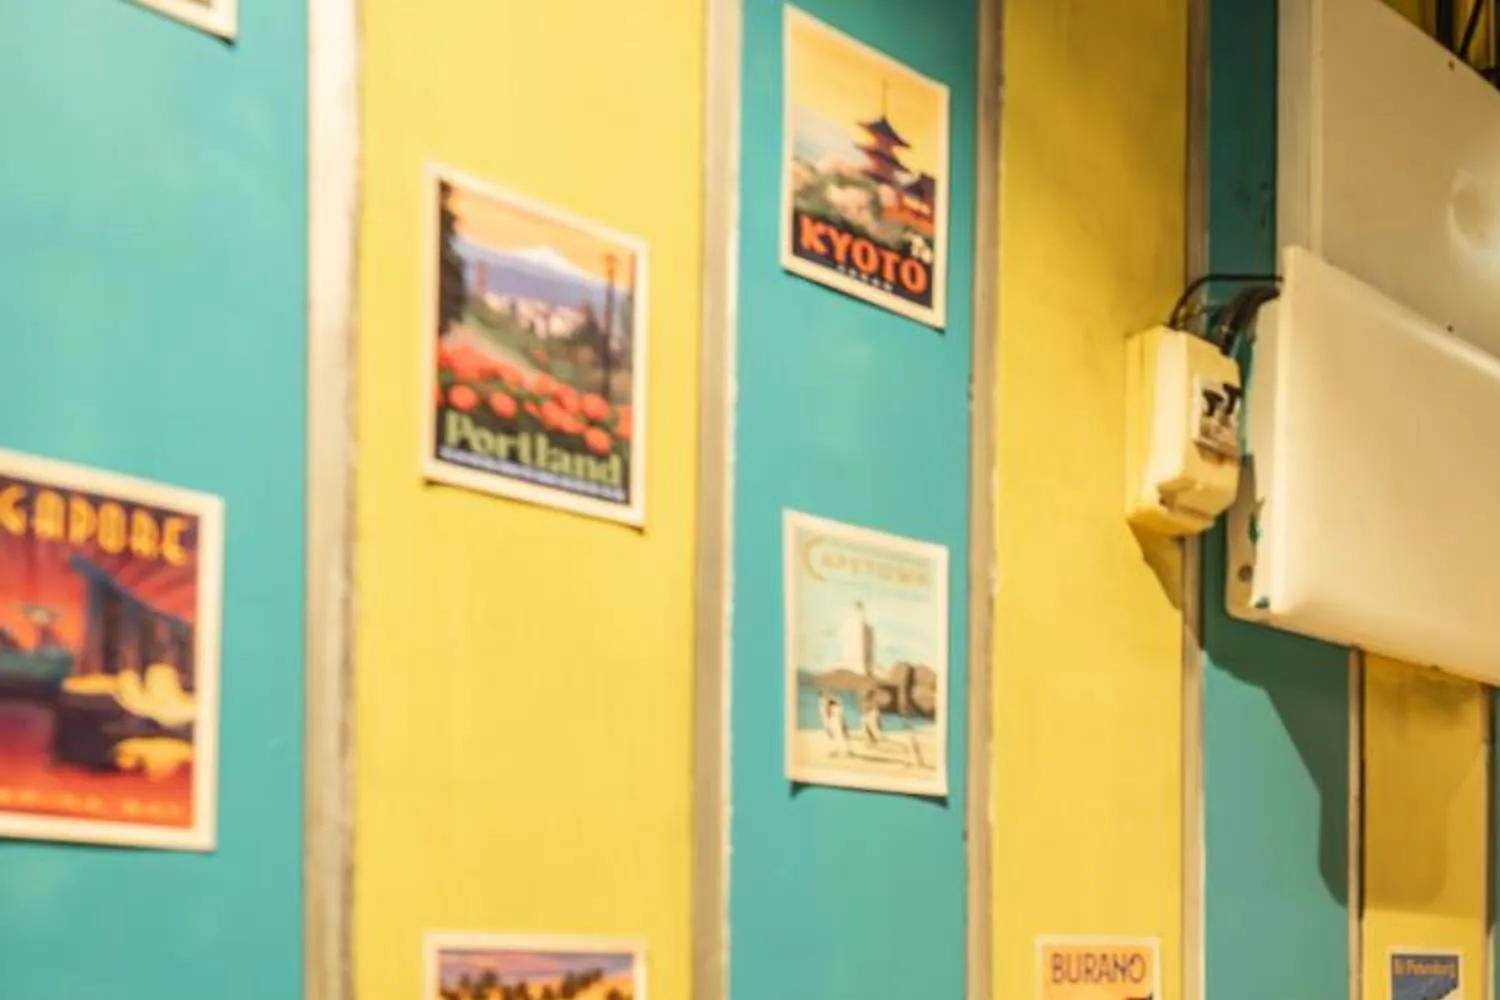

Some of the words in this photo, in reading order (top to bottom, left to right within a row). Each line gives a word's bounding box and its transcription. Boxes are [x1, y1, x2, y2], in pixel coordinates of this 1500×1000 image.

[801, 214, 929, 294] KYOTO
[445, 409, 622, 486] Portland
[1051, 952, 1146, 984] BURANO
